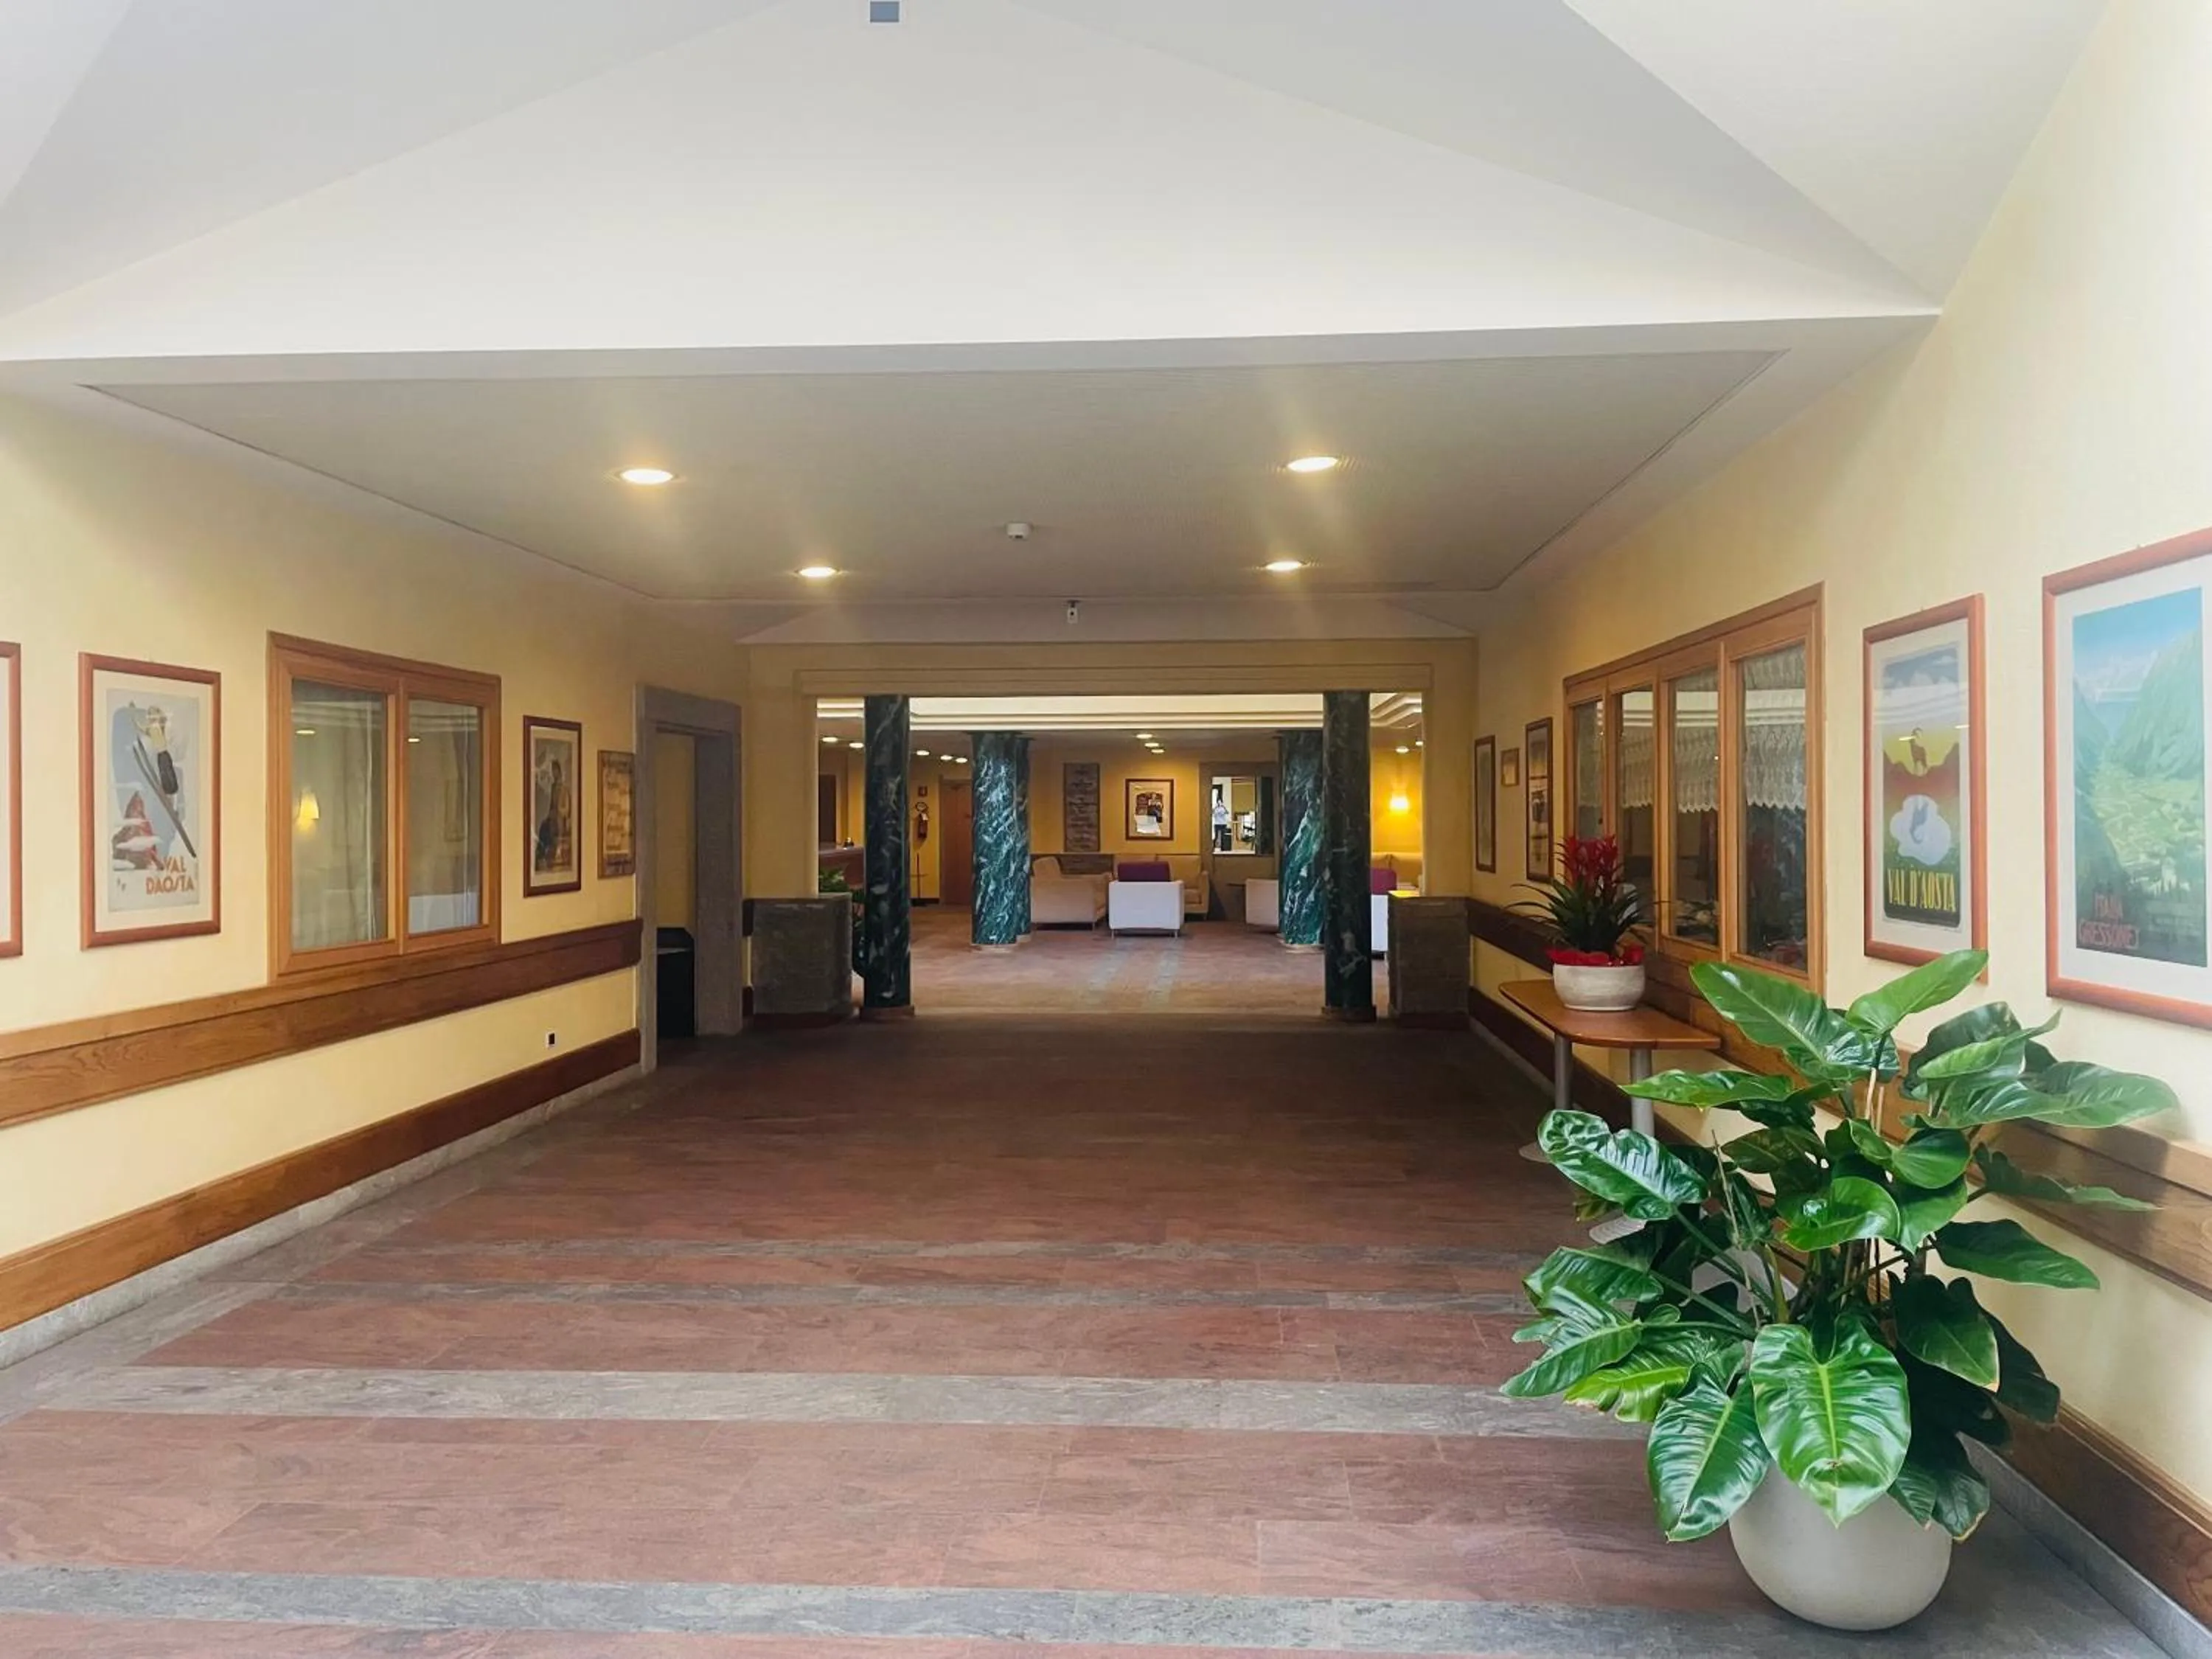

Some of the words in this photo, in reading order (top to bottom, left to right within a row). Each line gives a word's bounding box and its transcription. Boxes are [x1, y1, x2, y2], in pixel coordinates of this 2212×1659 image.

[164, 855, 187, 873] VAL
[1888, 869, 1906, 905] VAL
[1909, 869, 1956, 912] D'AOSTA
